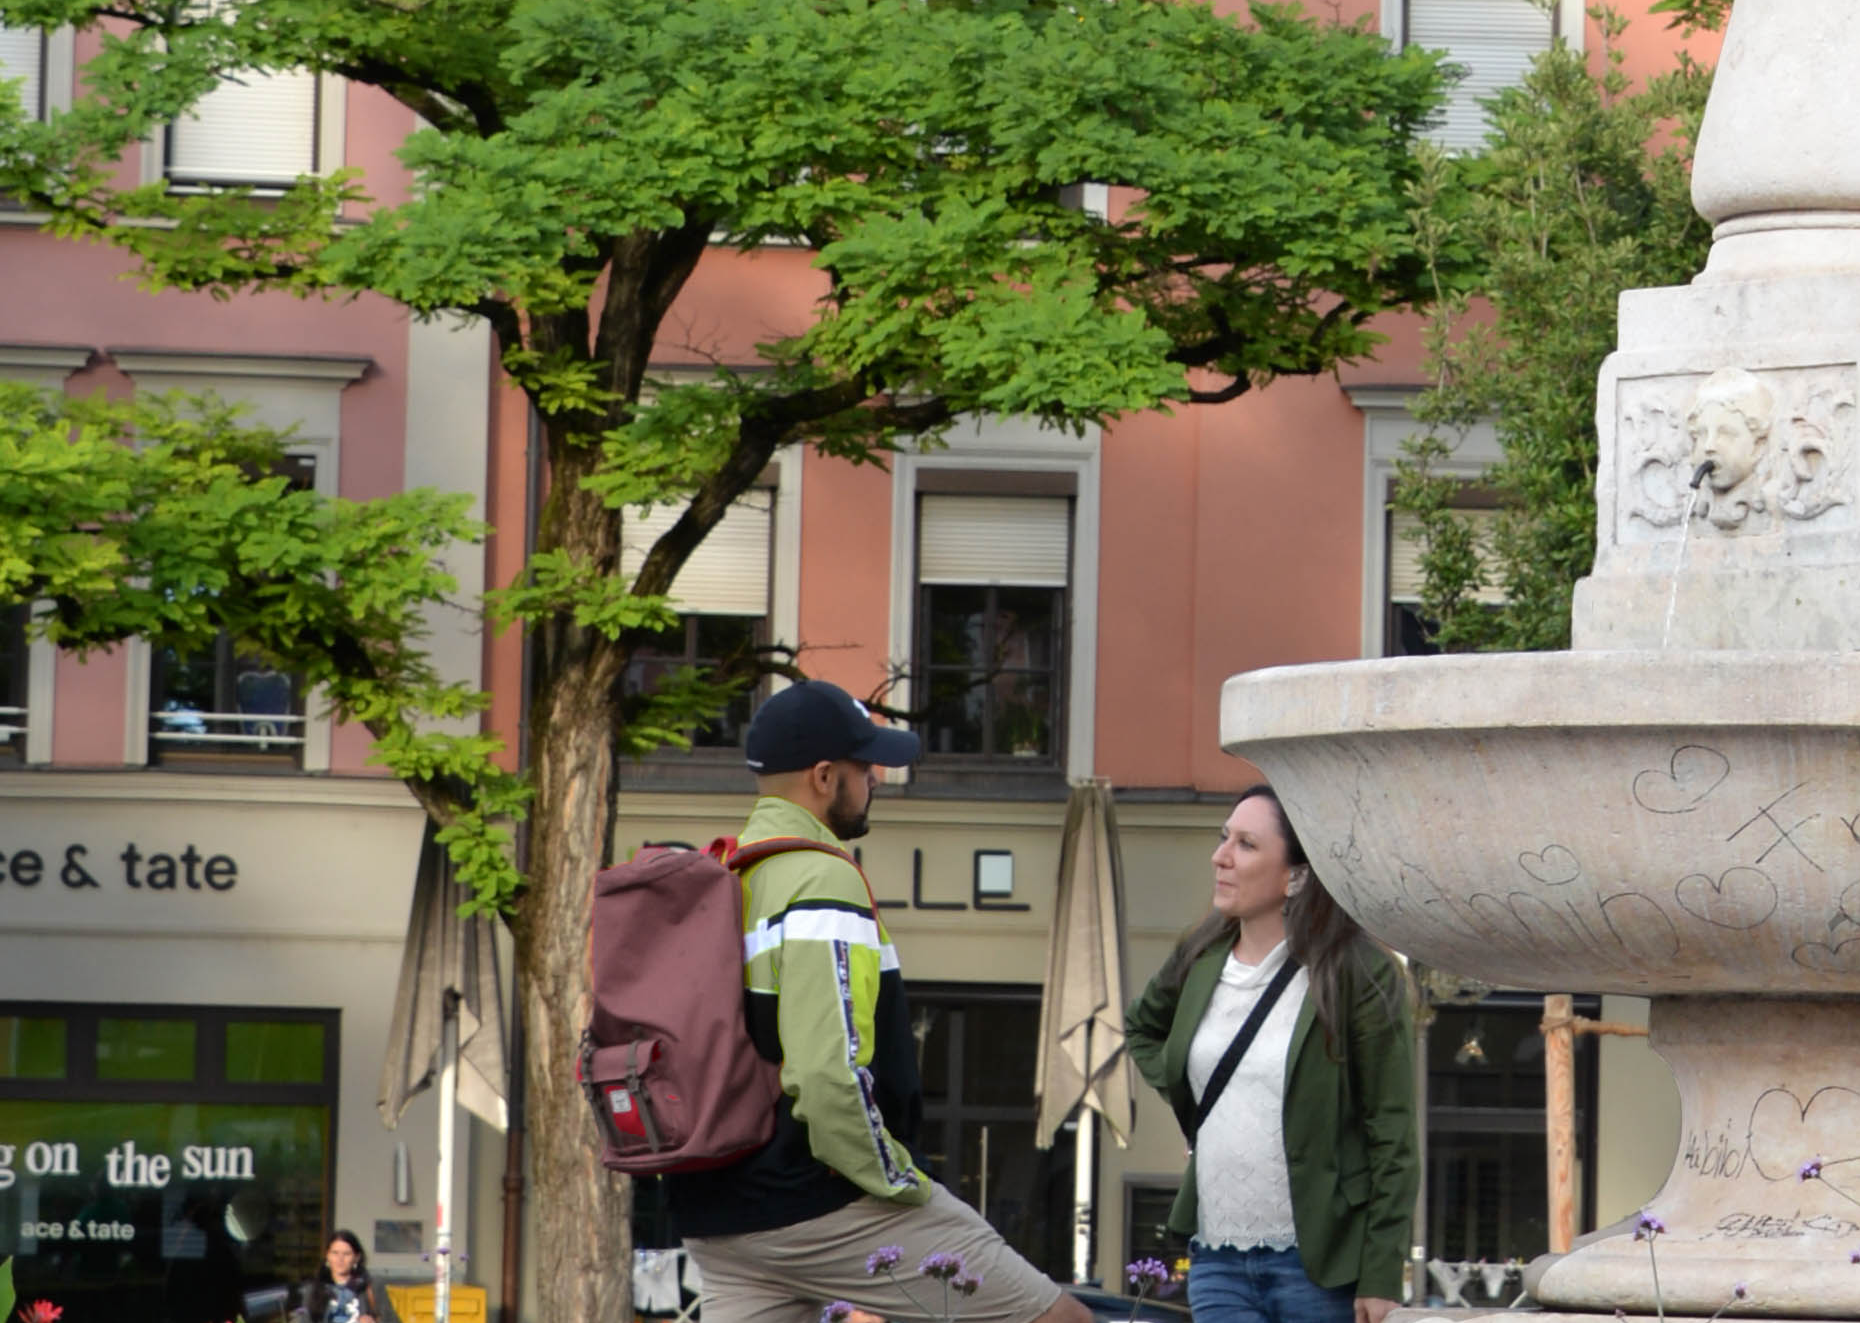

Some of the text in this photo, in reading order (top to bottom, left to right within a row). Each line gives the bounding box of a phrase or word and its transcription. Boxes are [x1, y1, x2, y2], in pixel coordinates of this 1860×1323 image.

[0, 842, 238, 891] e & tate
[25, 1141, 80, 1176] on
[104, 1140, 172, 1188] the
[182, 1145, 255, 1179] sun
[20, 1220, 136, 1241] ace & tate
